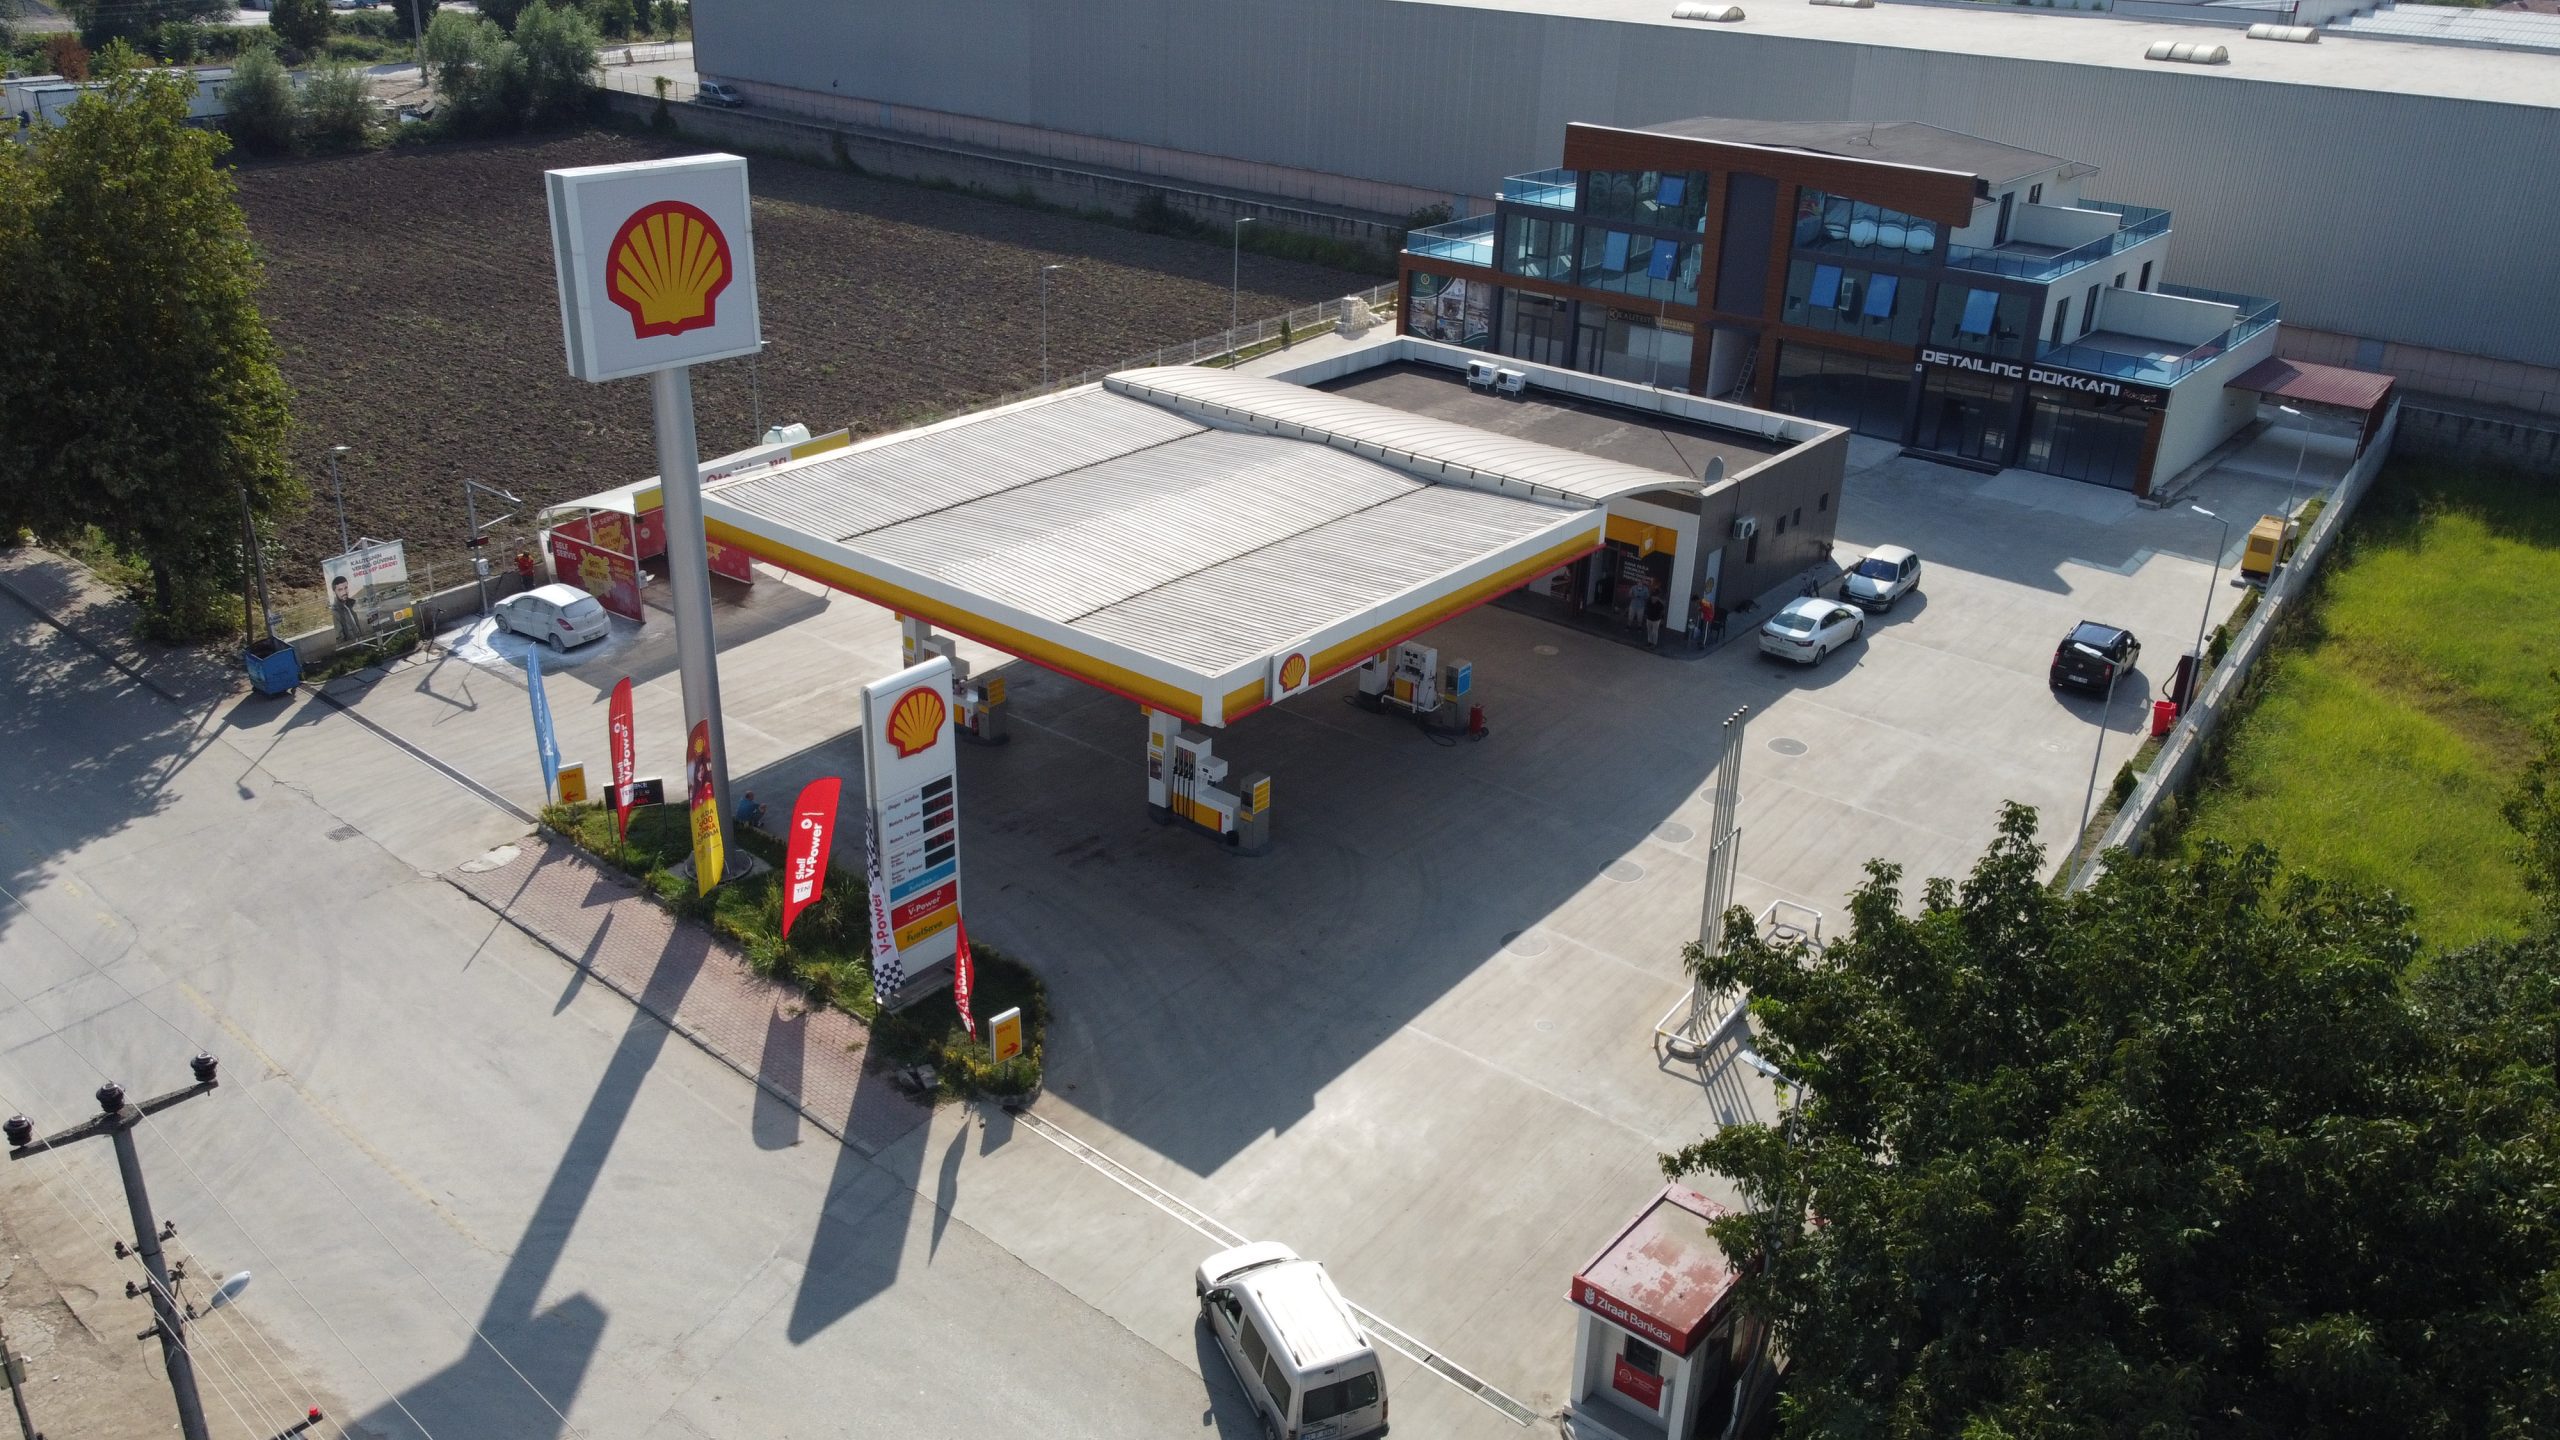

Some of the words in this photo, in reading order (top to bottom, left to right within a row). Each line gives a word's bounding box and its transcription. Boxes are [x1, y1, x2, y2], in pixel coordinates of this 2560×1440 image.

[1921, 349, 2023, 379] DETAILING
[622, 724, 633, 781] V-Power
[796, 858, 806, 880] Shell
[805, 823, 822, 878] V-Power
[872, 893, 892, 956] V-Power
[907, 896, 942, 916] V-Power
[1597, 1296, 1629, 1322] Ziraat
[1629, 1312, 1672, 1343] Bankası
